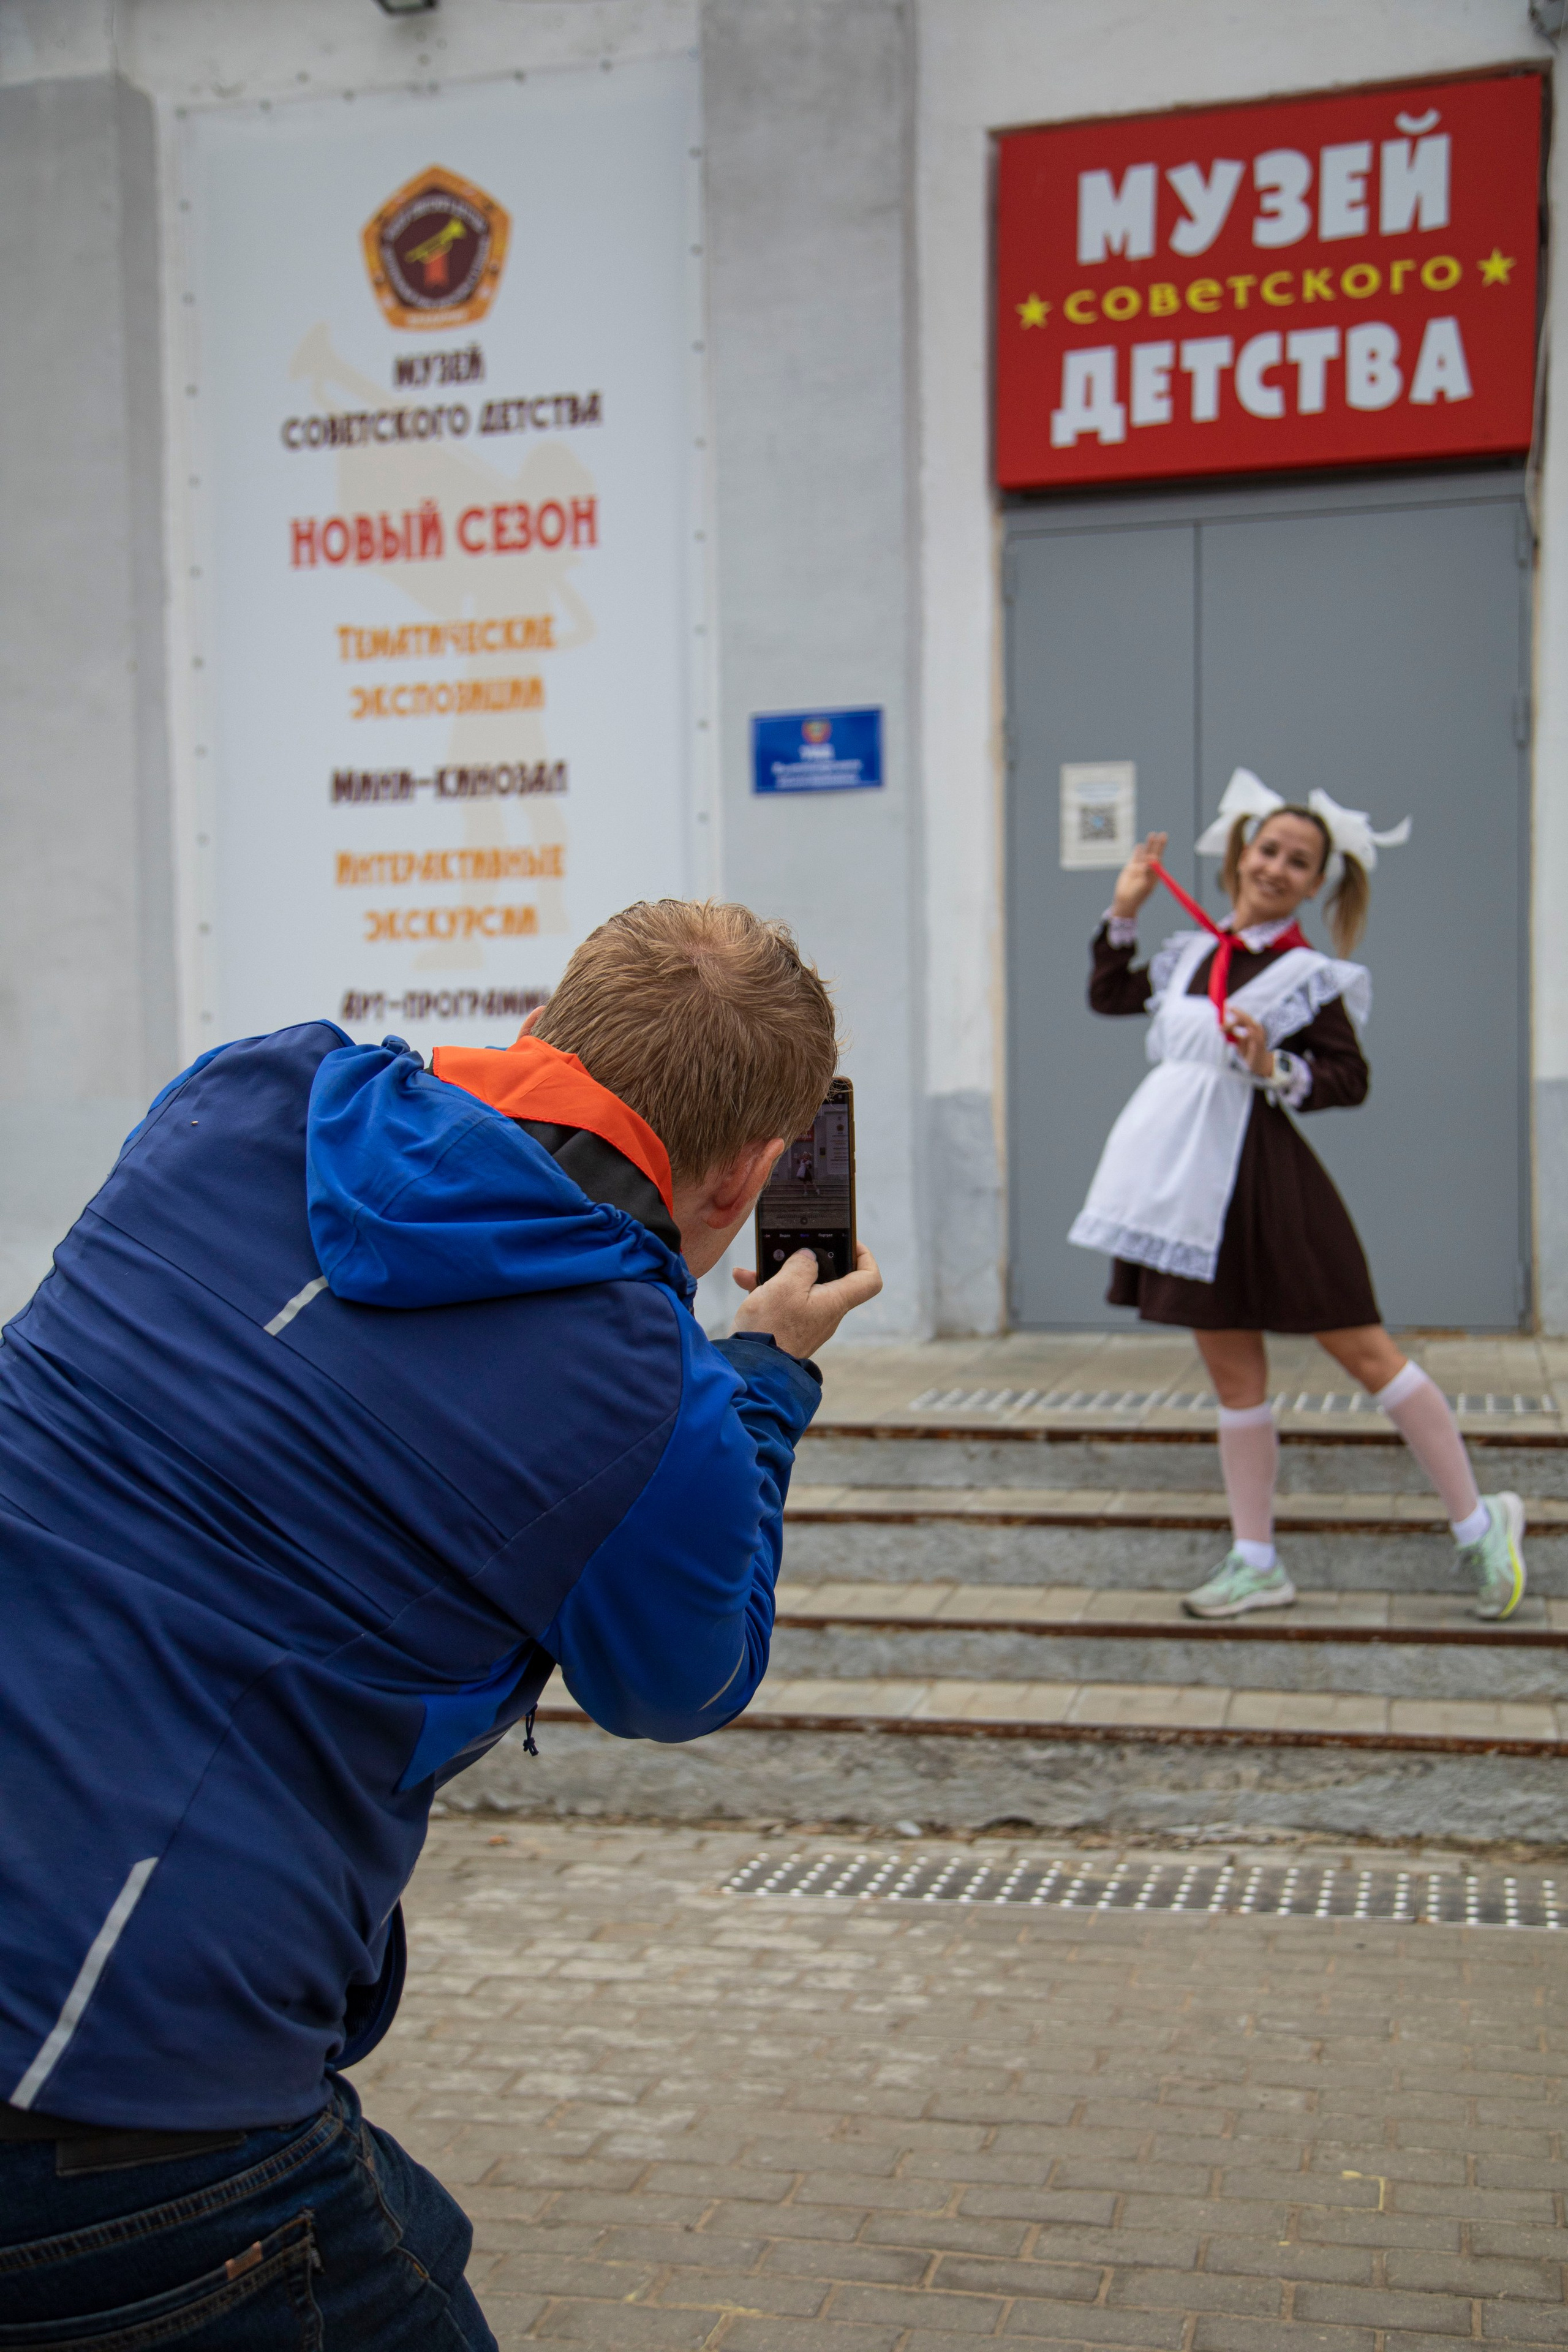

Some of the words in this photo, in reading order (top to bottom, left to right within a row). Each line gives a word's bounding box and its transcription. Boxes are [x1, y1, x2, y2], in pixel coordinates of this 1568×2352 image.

[1077, 107, 1452, 265] МУЗЕЙ
[393, 342, 485, 388] МУЗЕЙ
[1050, 316, 1473, 448] ДЕТСТВА
[282, 404, 470, 450] СОВЕТСКОГО
[478, 390, 602, 435] ДЕТСТВА
[290, 498, 444, 568] НОВЫЙ
[456, 495, 598, 554] СЕЗОН
[336, 614, 556, 662] ТЕМАТИЧЕСКИЕ
[350, 676, 546, 718] ЭКСПОЗИЦИИ
[331, 762, 568, 805] МИНИ-КИНОЗАЛ
[336, 845, 565, 886] ИНТЕРАКТИВНЫЕ
[364, 905, 539, 941] ЭКСКУРСИИ
[341, 987, 551, 1022] АРТ-ПРОГРАММ
